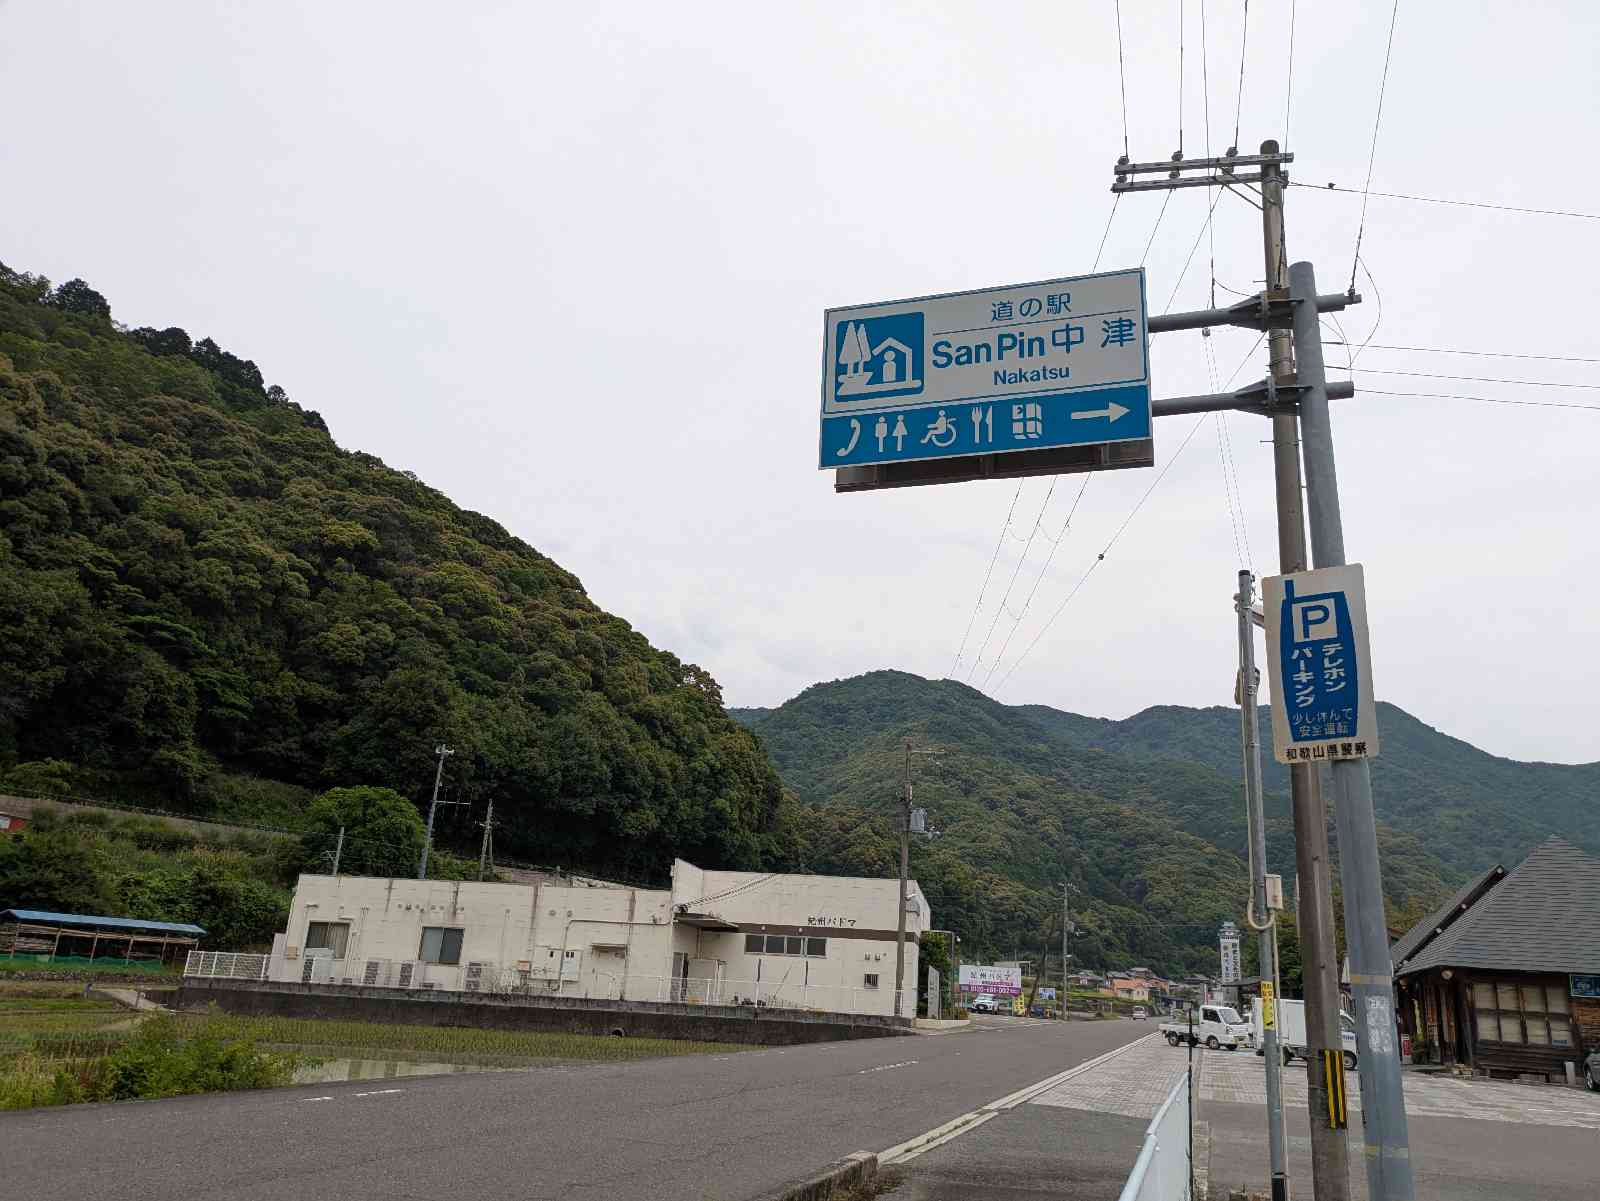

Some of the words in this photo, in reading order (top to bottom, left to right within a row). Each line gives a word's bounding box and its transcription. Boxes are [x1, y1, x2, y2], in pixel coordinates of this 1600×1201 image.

[991, 293, 1071, 321] 道の駅
[993, 366, 1070, 386] Nakatsu
[1301, 605, 1330, 640] P
[1322, 643, 1346, 693] テレホン
[1286, 741, 1368, 760] 和歌山県警察
